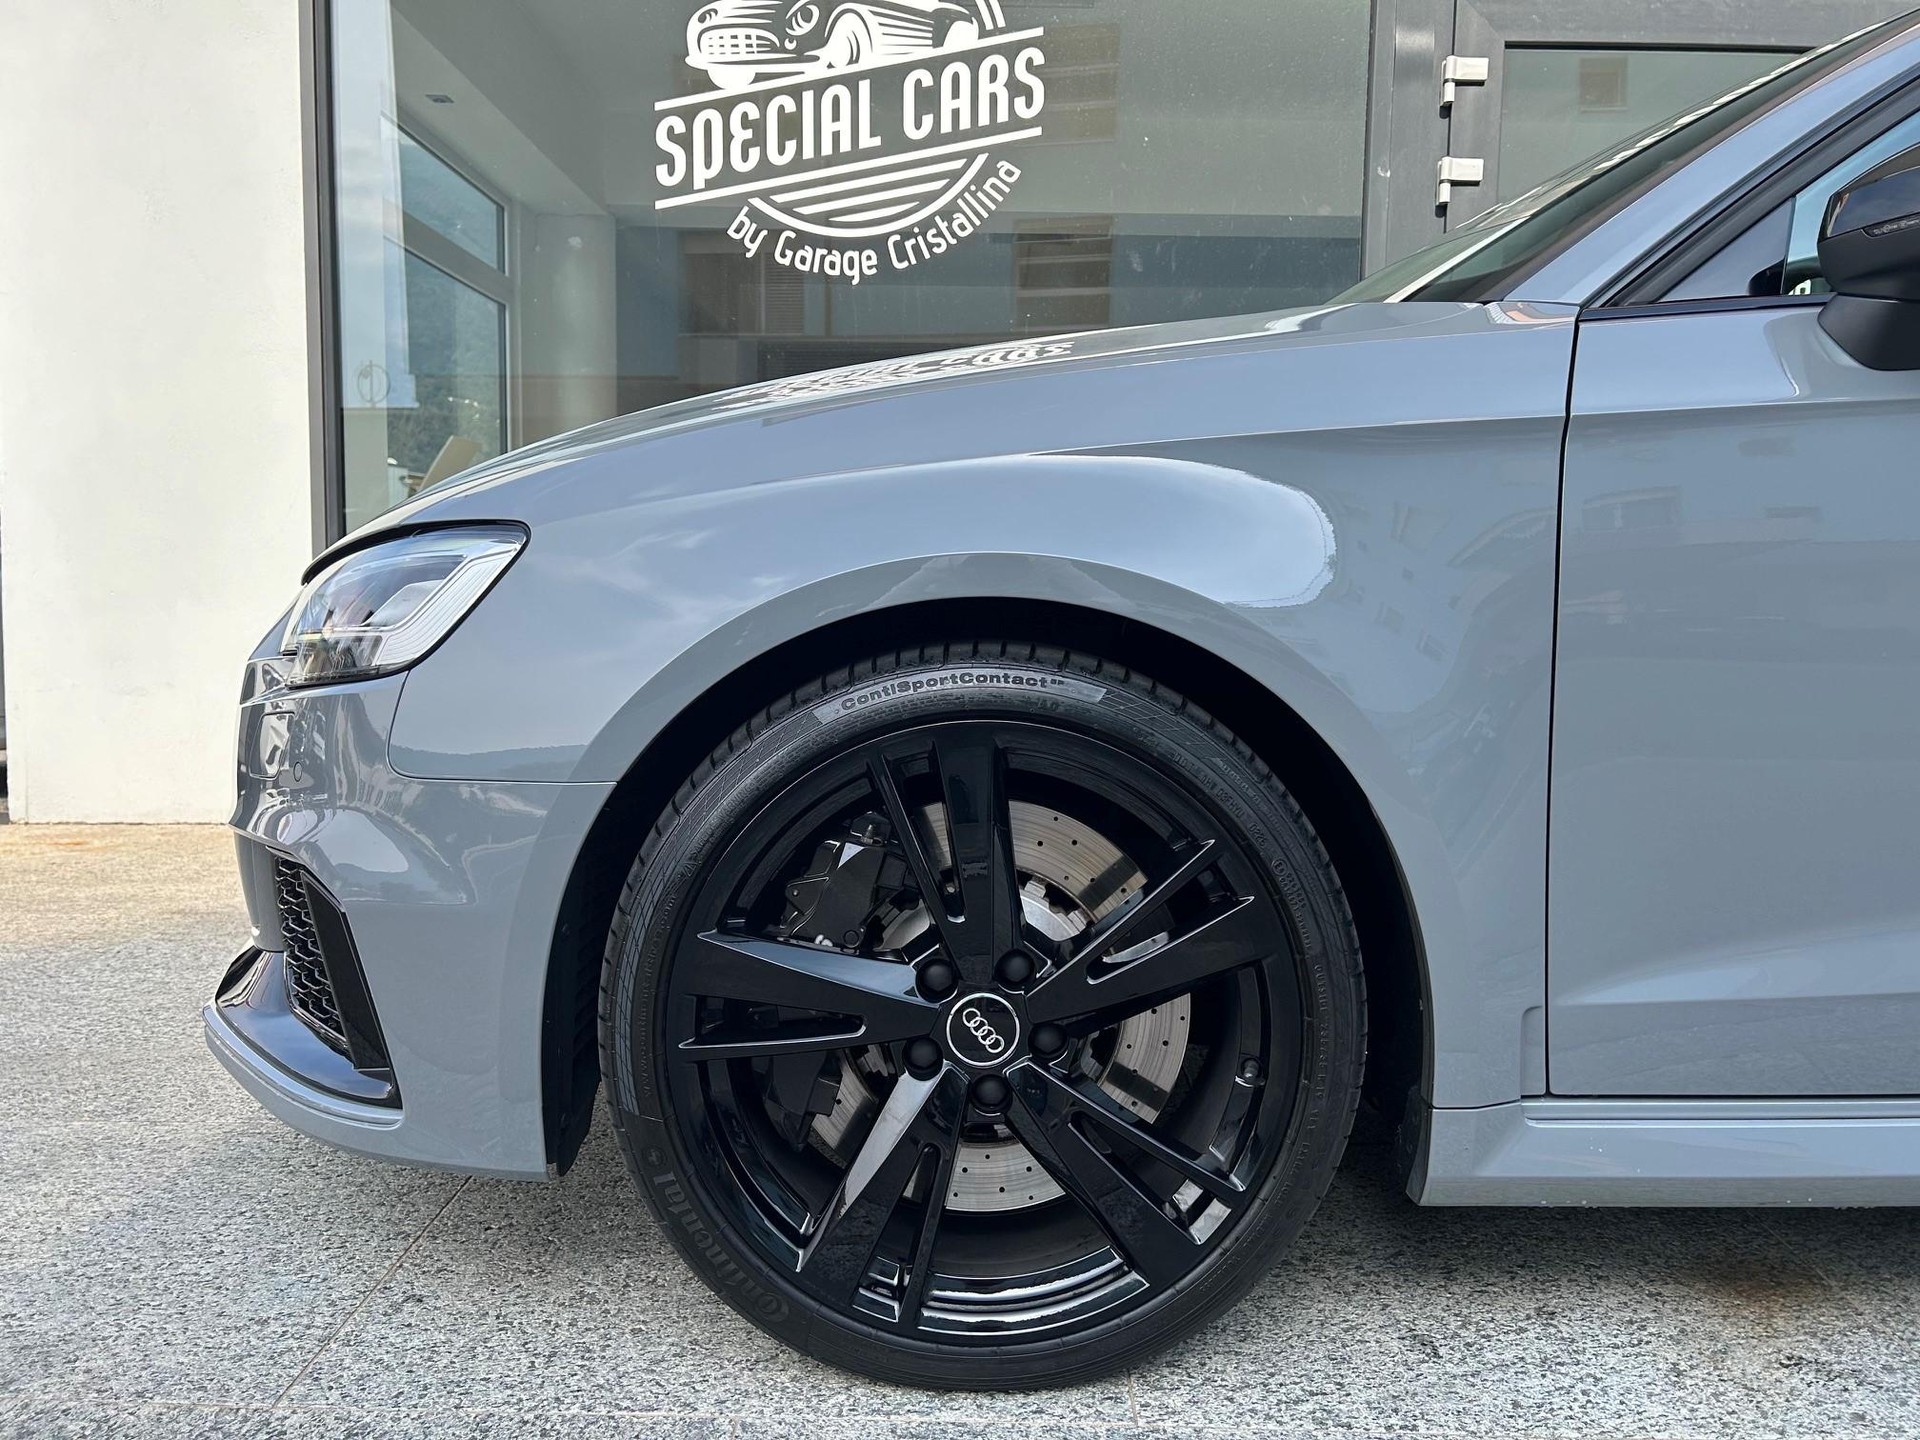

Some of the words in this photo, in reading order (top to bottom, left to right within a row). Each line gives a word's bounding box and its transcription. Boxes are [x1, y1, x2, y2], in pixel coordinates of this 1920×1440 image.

[655, 78, 882, 190] SPECIAL
[903, 47, 1046, 140] CARS
[726, 205, 768, 258] by
[774, 231, 878, 286] Garage
[887, 159, 1022, 270] Cristallina
[840, 672, 1048, 711] ContiSportContact
